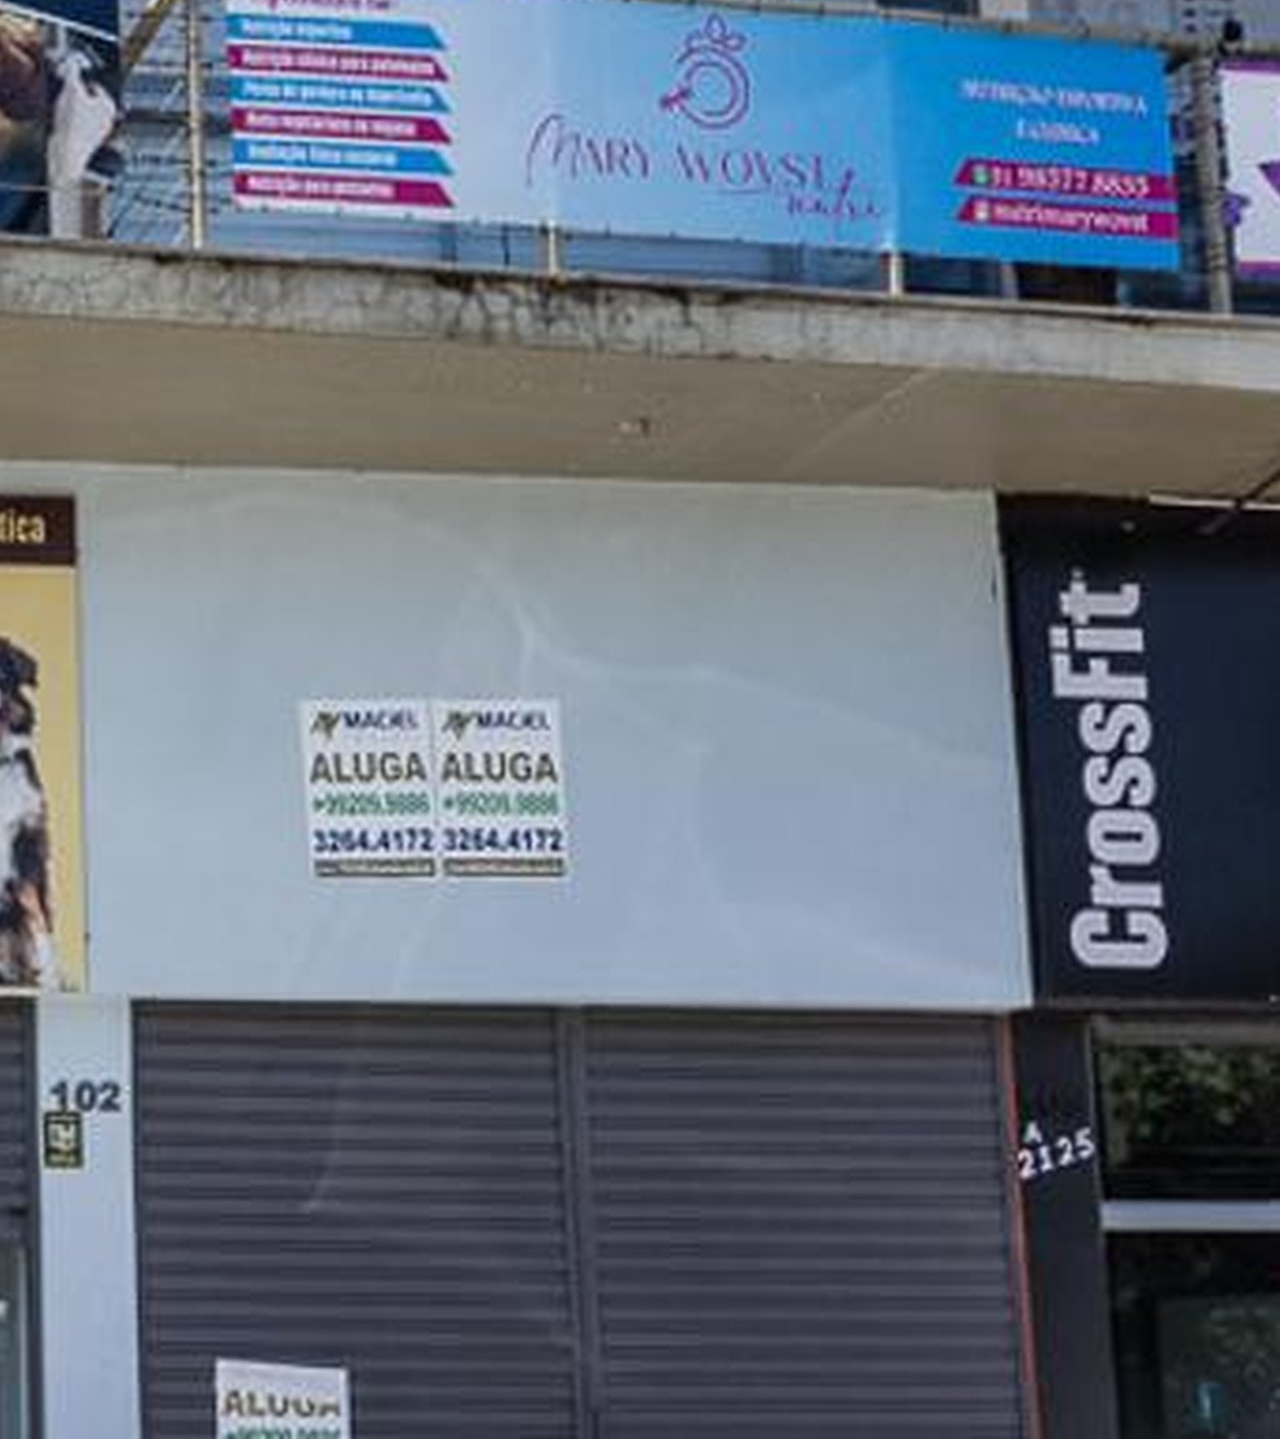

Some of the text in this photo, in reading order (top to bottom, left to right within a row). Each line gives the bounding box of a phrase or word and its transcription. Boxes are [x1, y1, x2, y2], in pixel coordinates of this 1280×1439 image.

[310, 751, 428, 784] ALUGA
[441, 751, 559, 784] ALUGA
[1049, 567, 1168, 970] CrossFit
[443, 829, 563, 853] 3264.4172
[49, 1079, 122, 1113] 102
[1017, 1125, 1096, 1180] 2125
